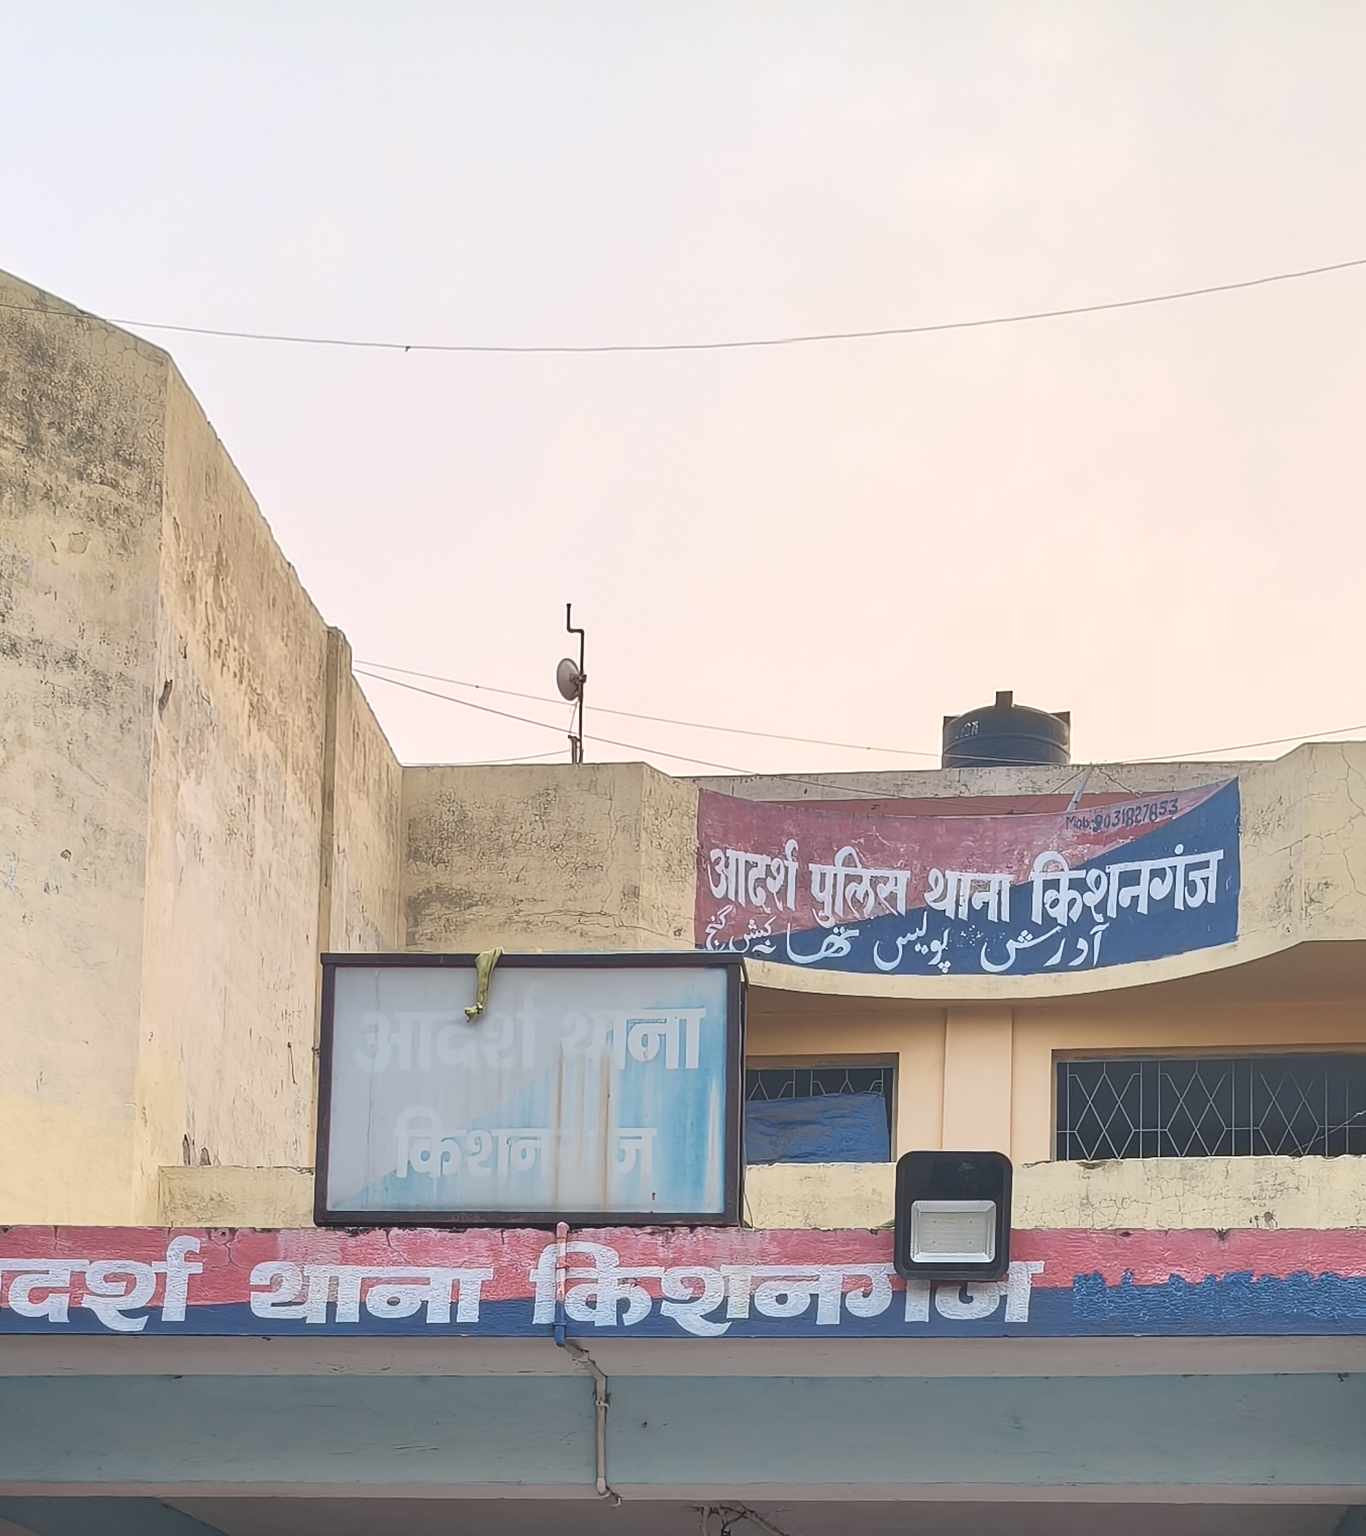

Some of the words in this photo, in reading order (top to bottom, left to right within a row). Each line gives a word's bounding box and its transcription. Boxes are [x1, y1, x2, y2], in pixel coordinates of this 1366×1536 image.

[708, 840, 798, 914] आदर्श
[810, 846, 910, 927] पुलिस
[925, 868, 1014, 922] थाना
[1030, 844, 1225, 927] किशनगंज
[354, 994, 534, 1073] आदर्श
[559, 1008, 706, 1070] थाना
[250, 1261, 493, 1324] थाना
